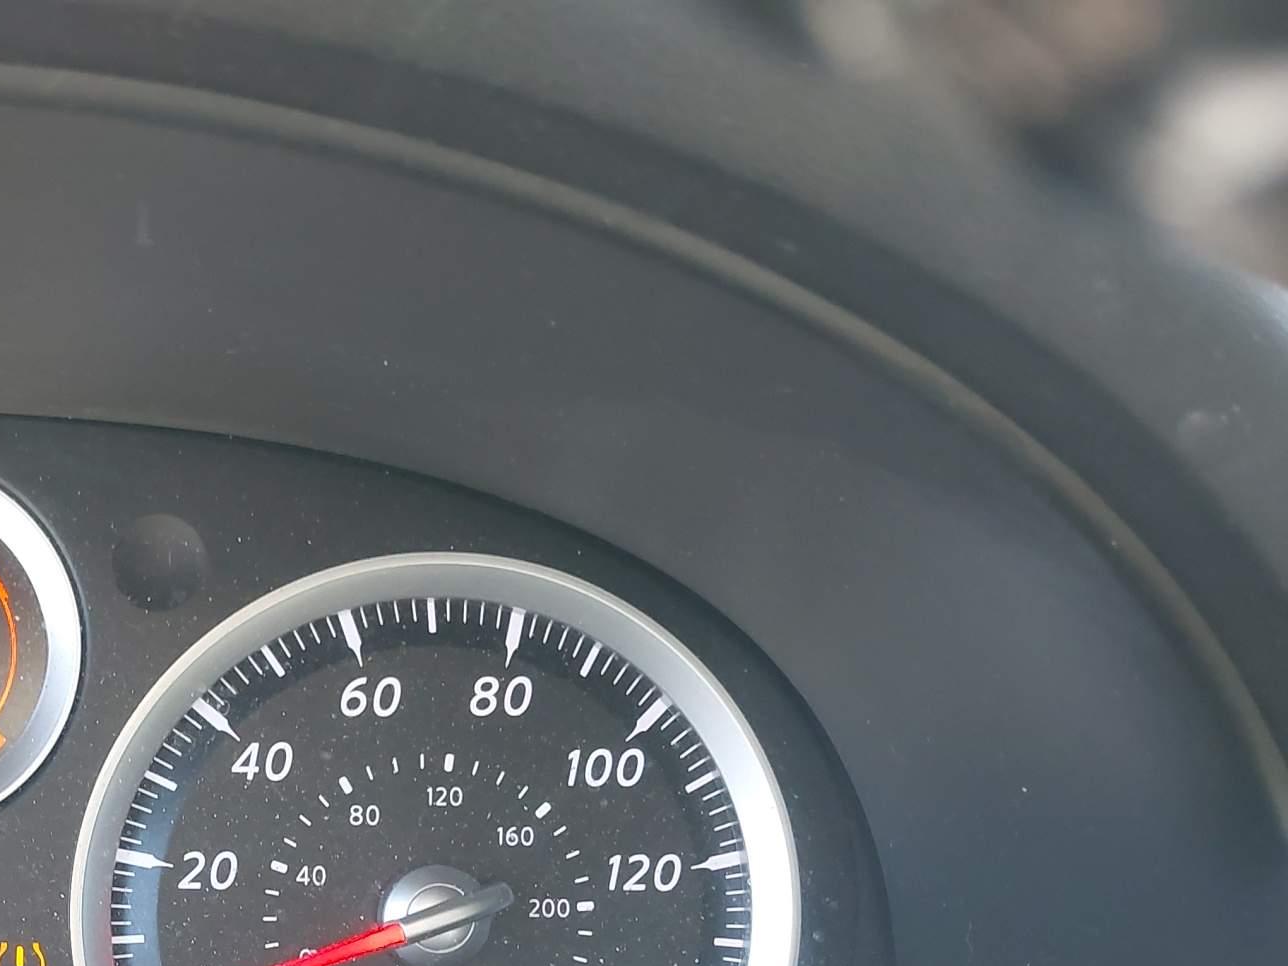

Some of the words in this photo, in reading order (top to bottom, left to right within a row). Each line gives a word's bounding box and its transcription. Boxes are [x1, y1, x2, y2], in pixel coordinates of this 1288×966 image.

[340, 676, 402, 718] 60
[469, 675, 533, 717] 80
[231, 741, 293, 782] 40
[567, 748, 645, 788] 100
[349, 804, 380, 826] 80
[426, 786, 463, 807] 120
[496, 826, 535, 847] 160
[177, 850, 238, 891] 20
[295, 865, 327, 887] 40
[608, 853, 682, 892] 120
[528, 898, 570, 919] 200
